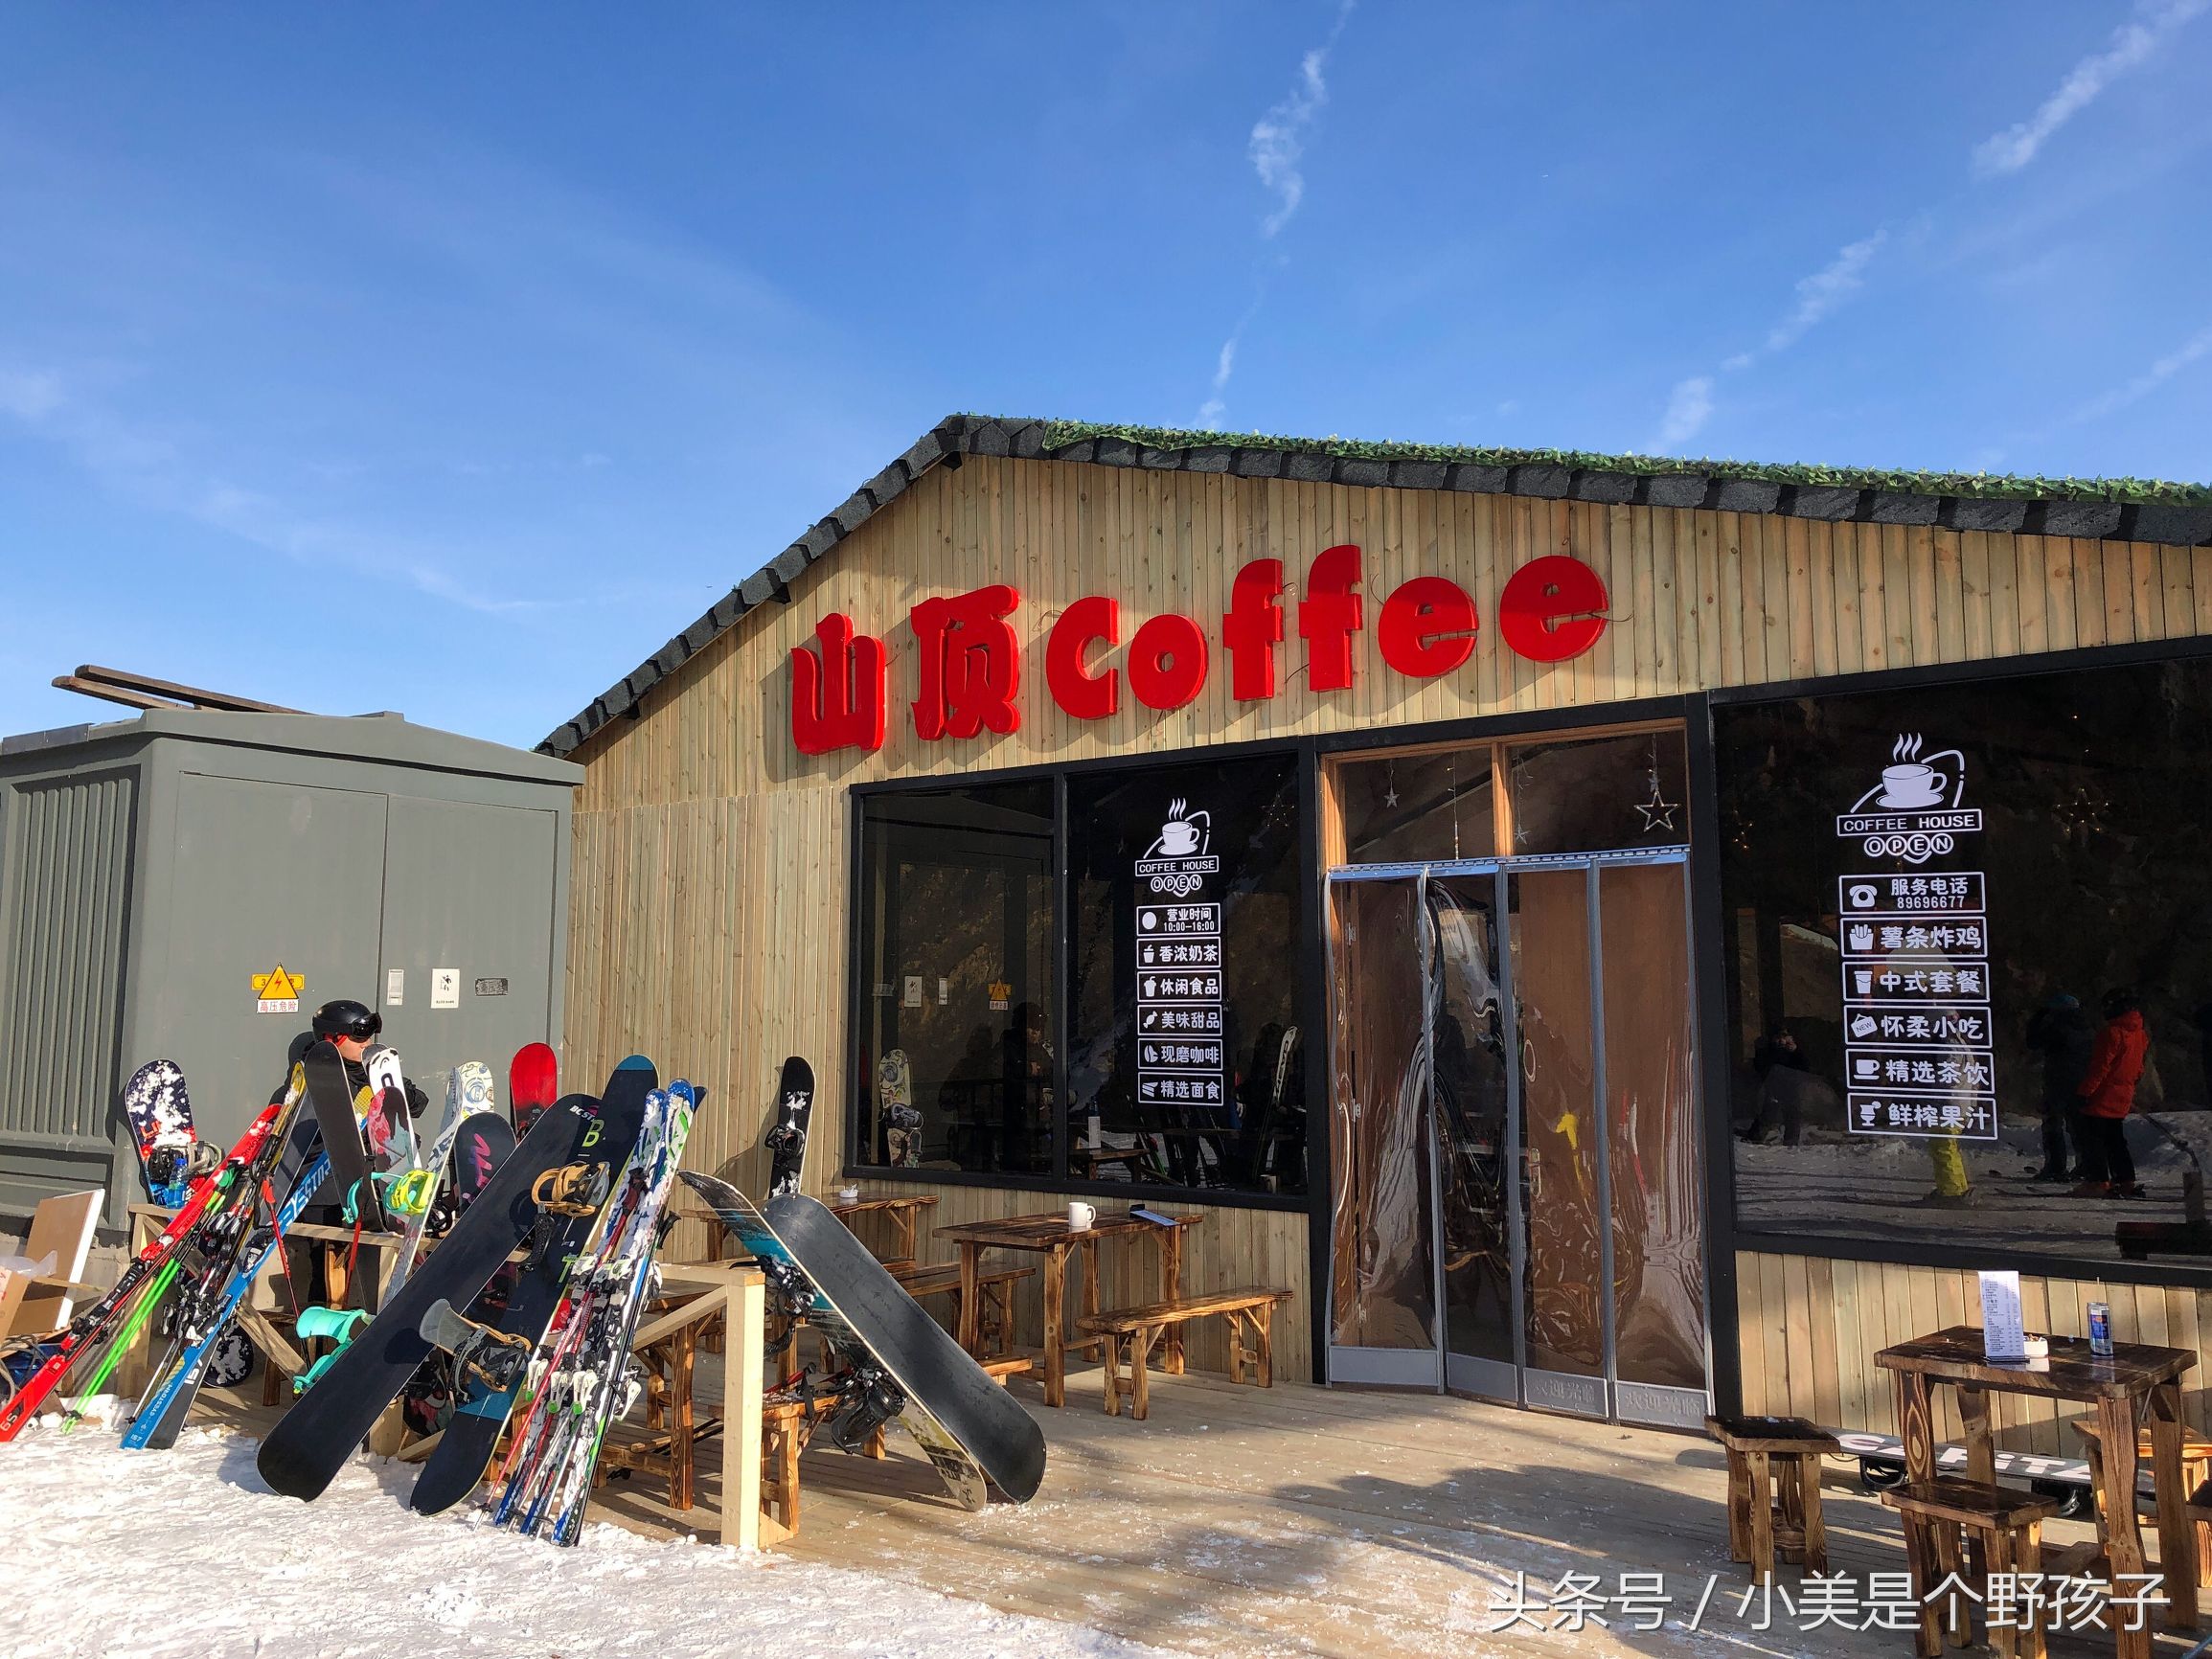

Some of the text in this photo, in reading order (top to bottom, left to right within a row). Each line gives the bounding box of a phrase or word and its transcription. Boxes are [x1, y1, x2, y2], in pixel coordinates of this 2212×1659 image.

[790, 584, 1020, 755] 山顶
[1844, 814, 1975, 832] COFFEE HOUSE
[1866, 835, 1951, 855] OPEN
[1139, 860, 1216, 873] COFFEE HOUSE
[1152, 875, 1201, 891] OPEN
[1891, 876, 1969, 897] 服务电话
[1897, 896, 1965, 909] 89696677
[1167, 907, 1212, 921] 营业时间
[1881, 925, 1982, 949] 薯条炸鸡
[1159, 944, 1218, 963] 香浓奶茶
[1160, 977, 1219, 995] 休闲食品
[1880, 969, 1981, 994] 中式套餐
[260, 1001, 297, 1012] 高压危险
[1161, 1011, 1220, 1029] 美味甜品
[1857, 1021, 1873, 1033] NEW
[1881, 1015, 1984, 1040] 怀柔小吃
[1161, 1045, 1220, 1064] 现磨咖啡
[1885, 1058, 1990, 1086] 精选茶饮
[1160, 1079, 1220, 1100] 精选面食
[1887, 1102, 1991, 1130] 鲜榨果汁
[1625, 1391, 1700, 1418] 欢迎光临
